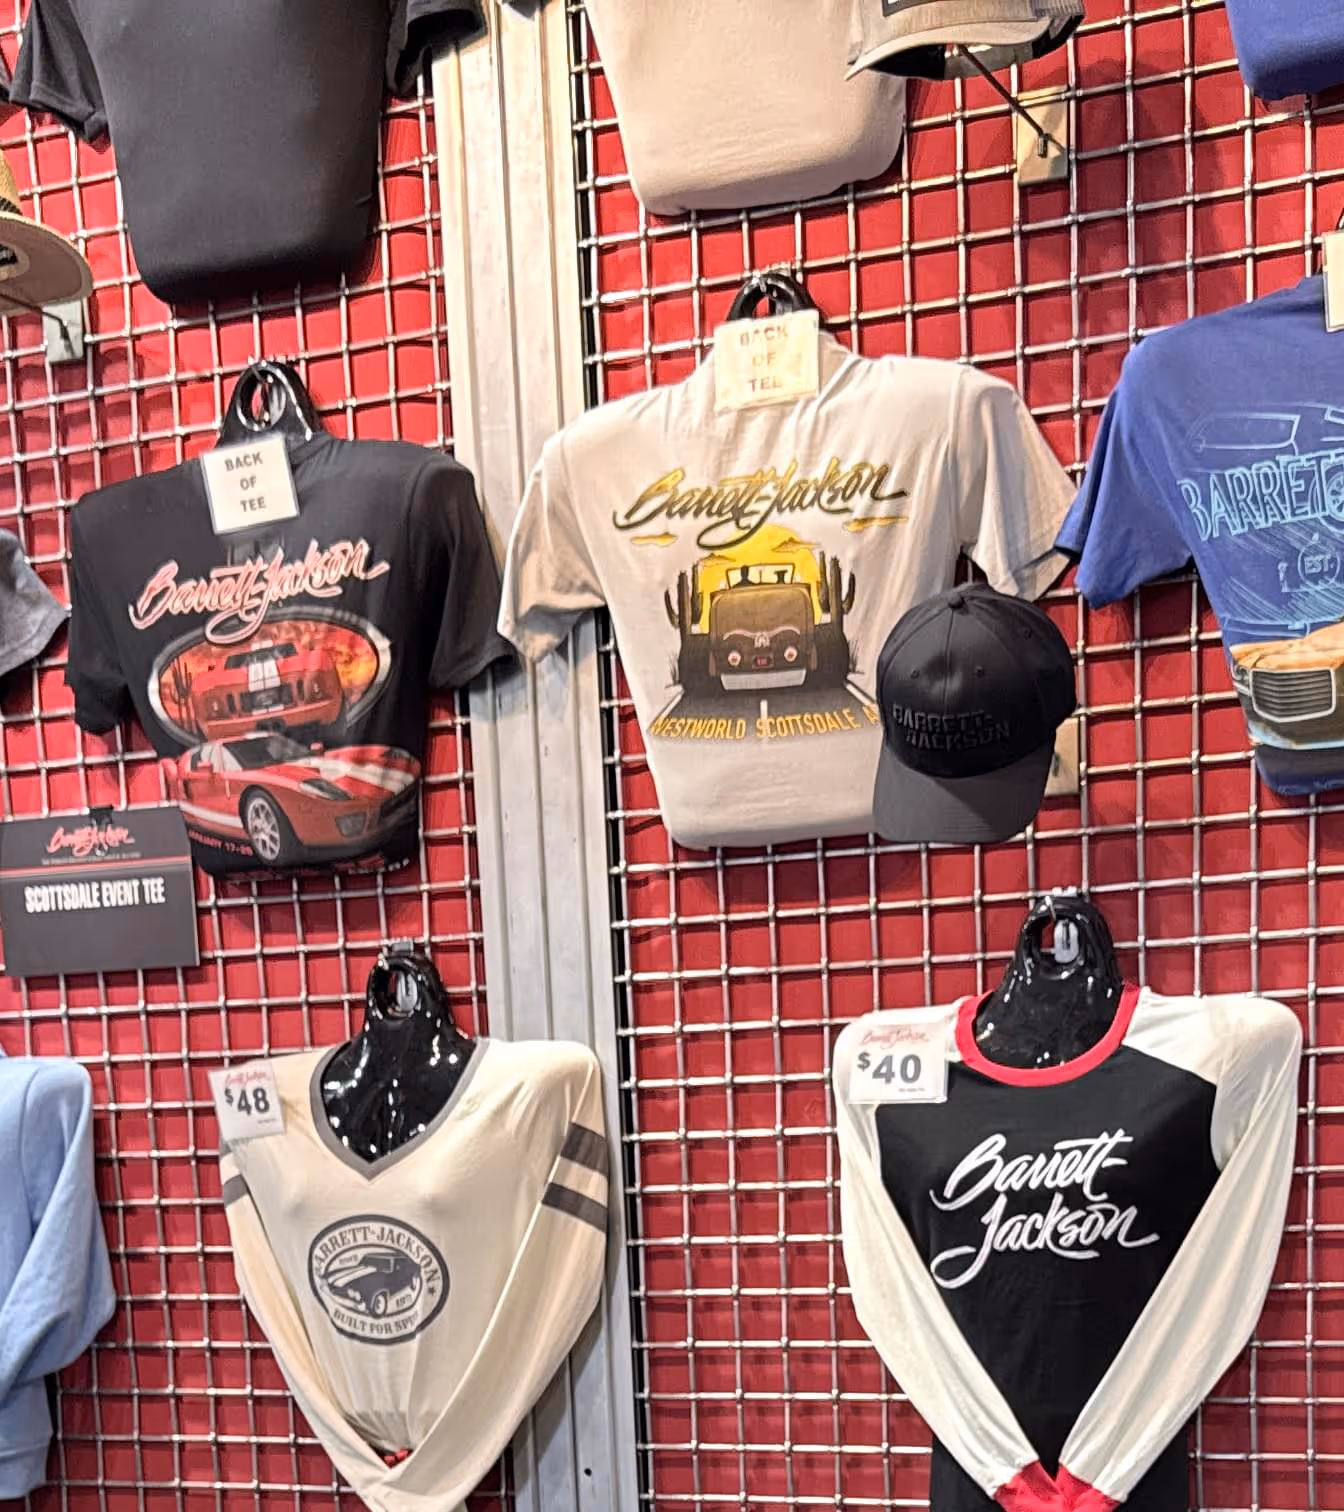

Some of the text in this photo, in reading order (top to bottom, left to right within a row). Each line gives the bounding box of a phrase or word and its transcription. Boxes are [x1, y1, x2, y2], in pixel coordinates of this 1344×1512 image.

[752, 351, 778, 369] OF
[224, 452, 264, 473] BACK
[238, 475, 259, 491] OF
[239, 497, 267, 513] TEE
[613, 457, 912, 550] Barrett-Jackson
[129, 536, 390, 646] Barrett-Jackson
[650, 714, 747, 741] WESTWORLD
[755, 708, 863, 739] SCOTTSDALE
[24, 876, 167, 914] SCOTTSDALE EVENT TEE
[857, 1050, 922, 1085] $40
[224, 1086, 271, 1117] $48
[929, 1128, 1135, 1211] Barrett-
[930, 1192, 1161, 1290] Jackson
[332, 1308, 368, 1333] BUILT
[369, 1322, 394, 1336] FOR
